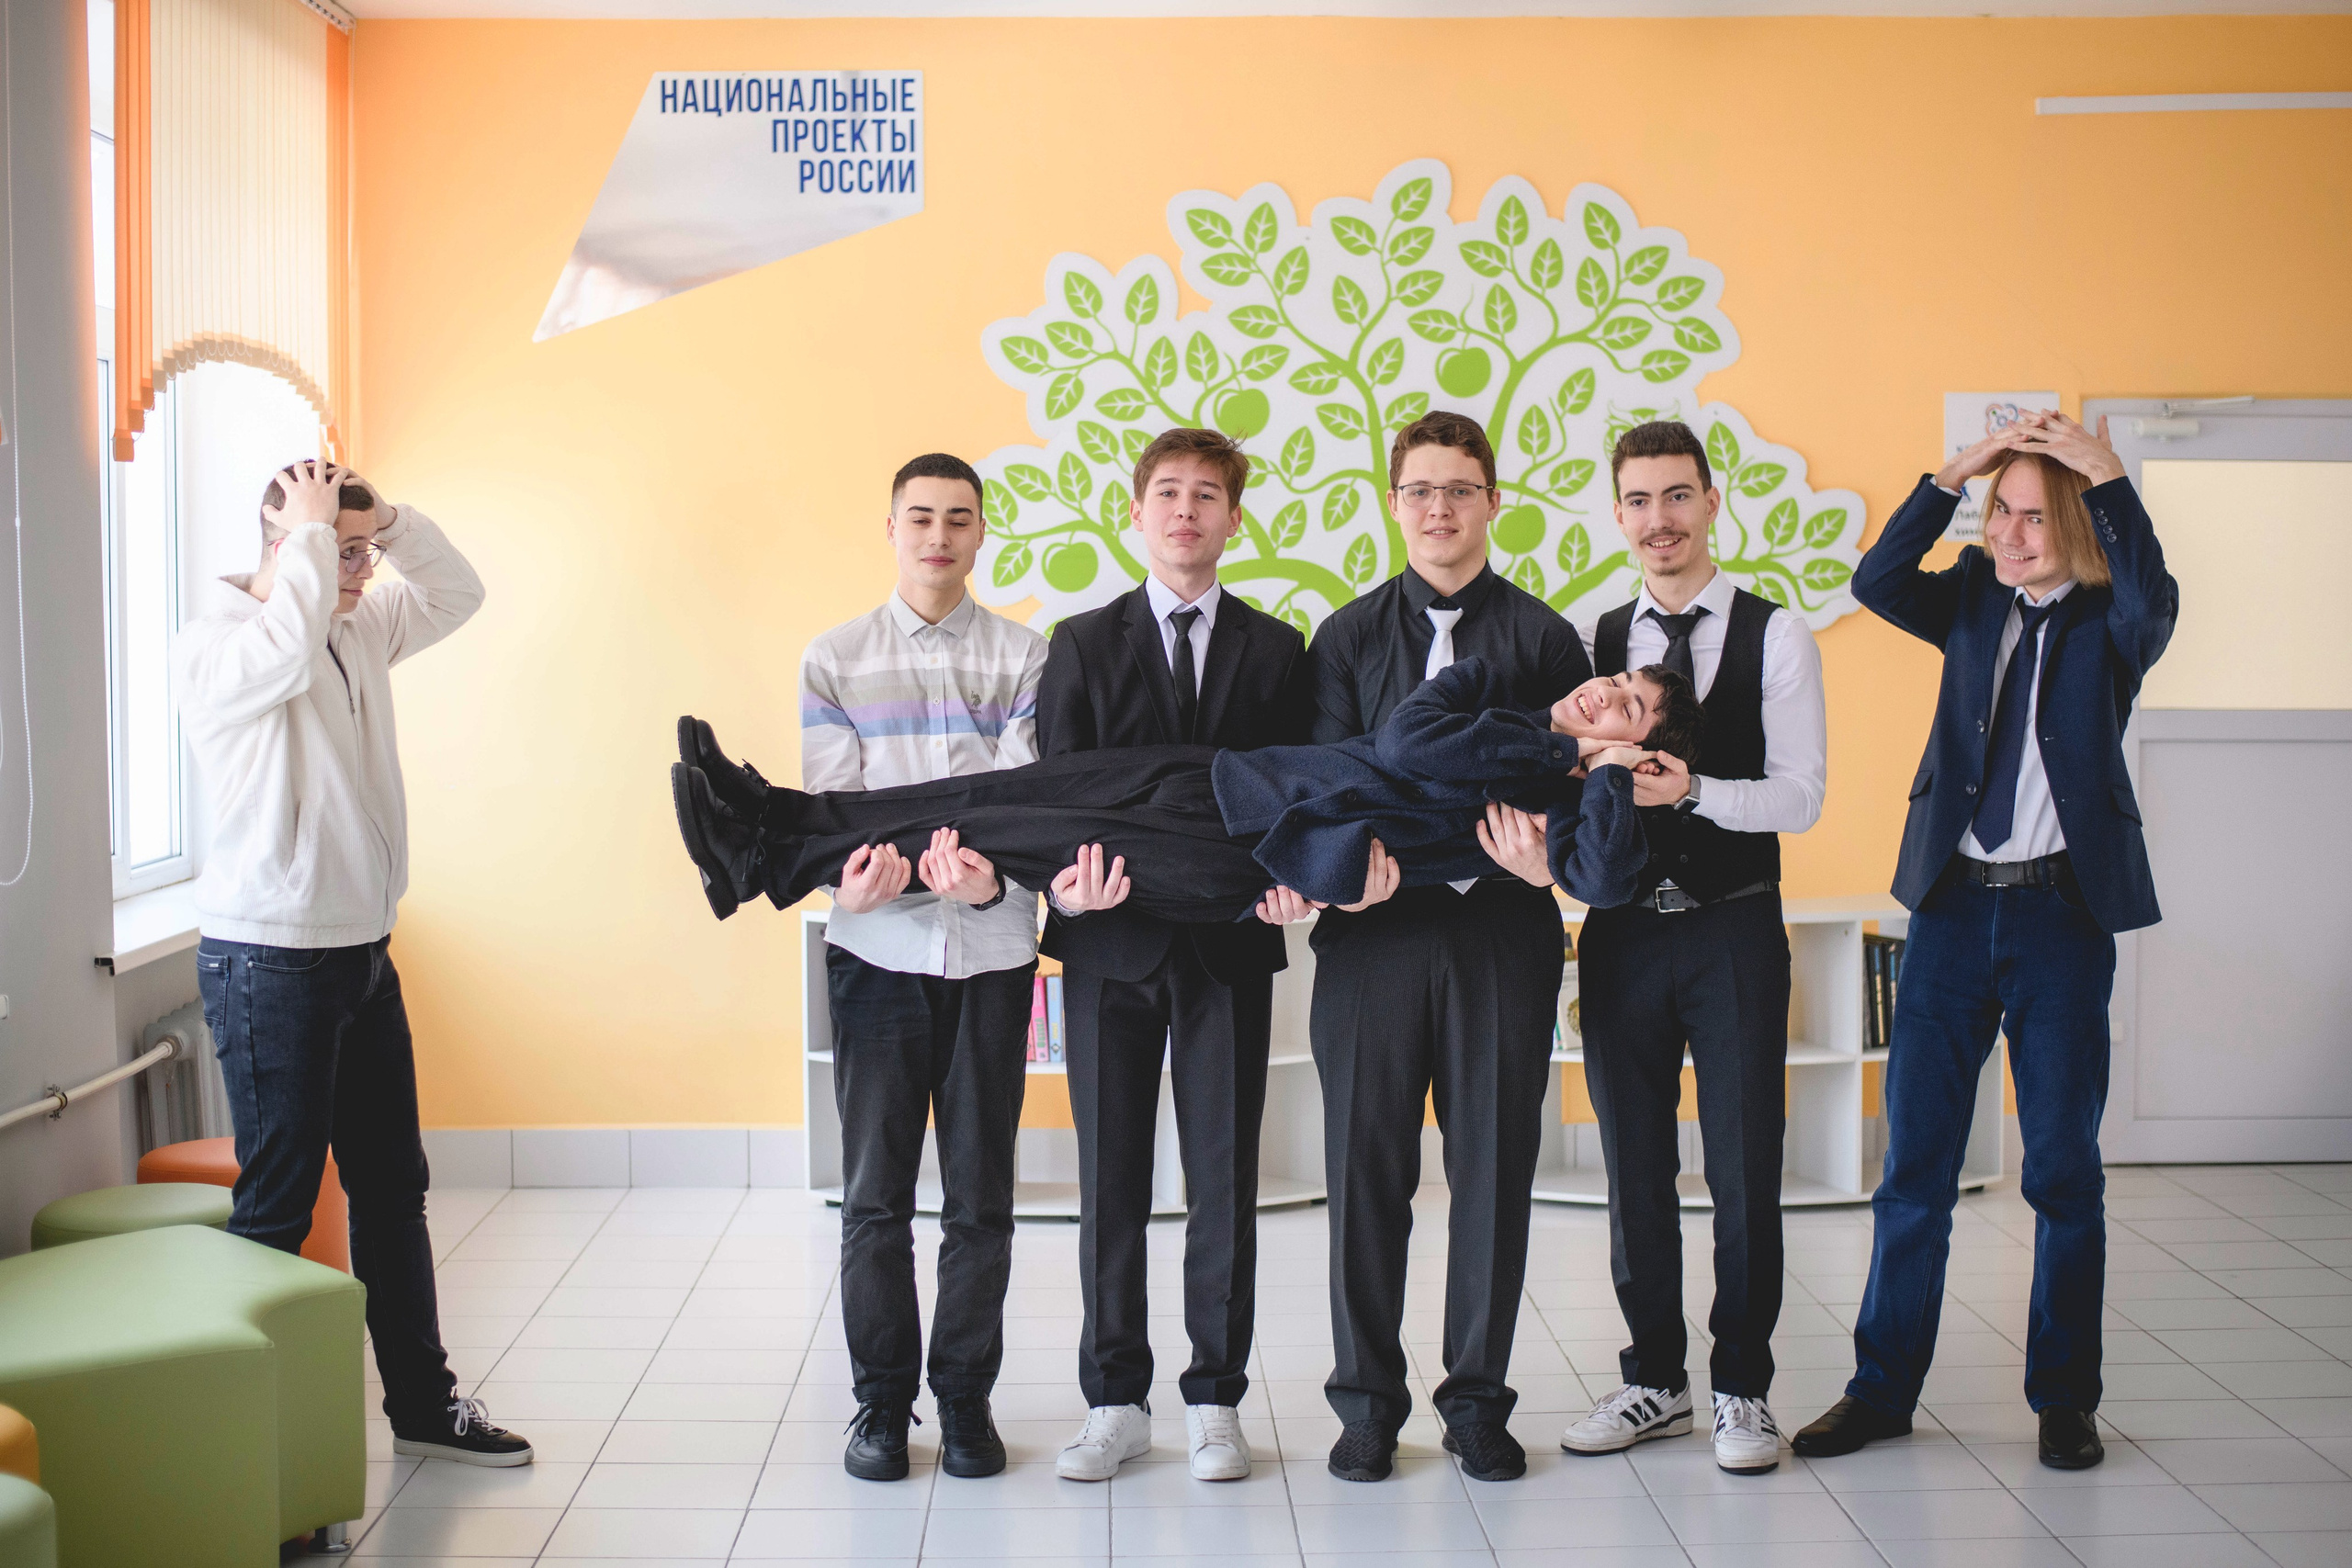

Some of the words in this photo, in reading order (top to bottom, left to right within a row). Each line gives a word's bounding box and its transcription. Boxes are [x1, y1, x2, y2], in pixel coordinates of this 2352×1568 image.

[661, 78, 915, 117] НАЦИОНАЛЬНЫЕ
[773, 118, 915, 152] ПРОЕКТЫ
[799, 159, 915, 193] РОССИИ
